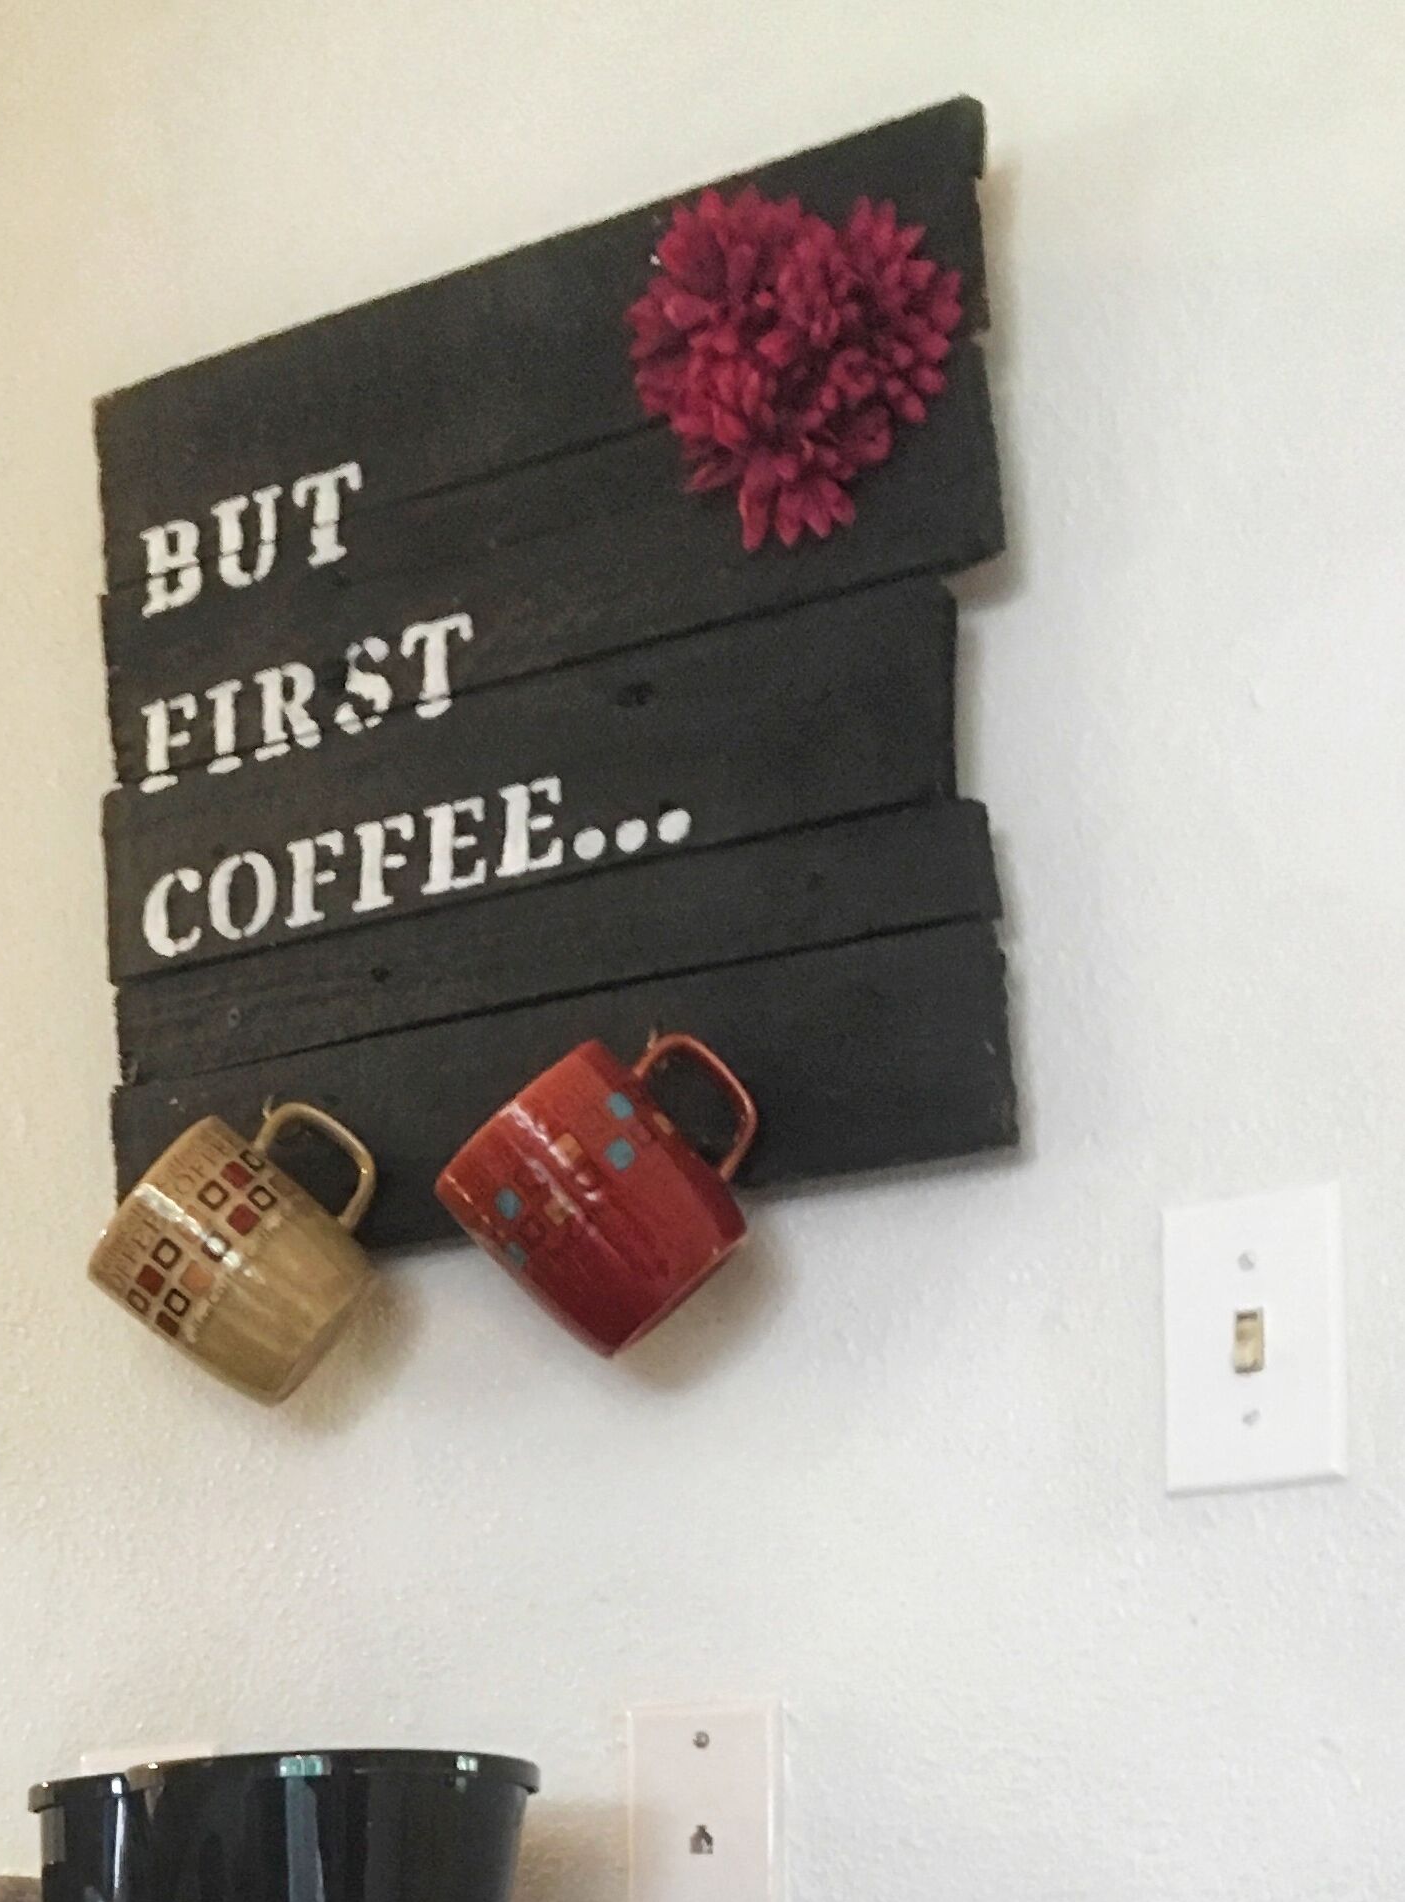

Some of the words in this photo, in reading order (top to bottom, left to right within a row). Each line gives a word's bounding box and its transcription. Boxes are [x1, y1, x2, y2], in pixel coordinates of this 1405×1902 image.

[138, 461, 363, 618] BUT
[139, 612, 474, 794] FIRST
[142, 775, 693, 958] COFFEE...
